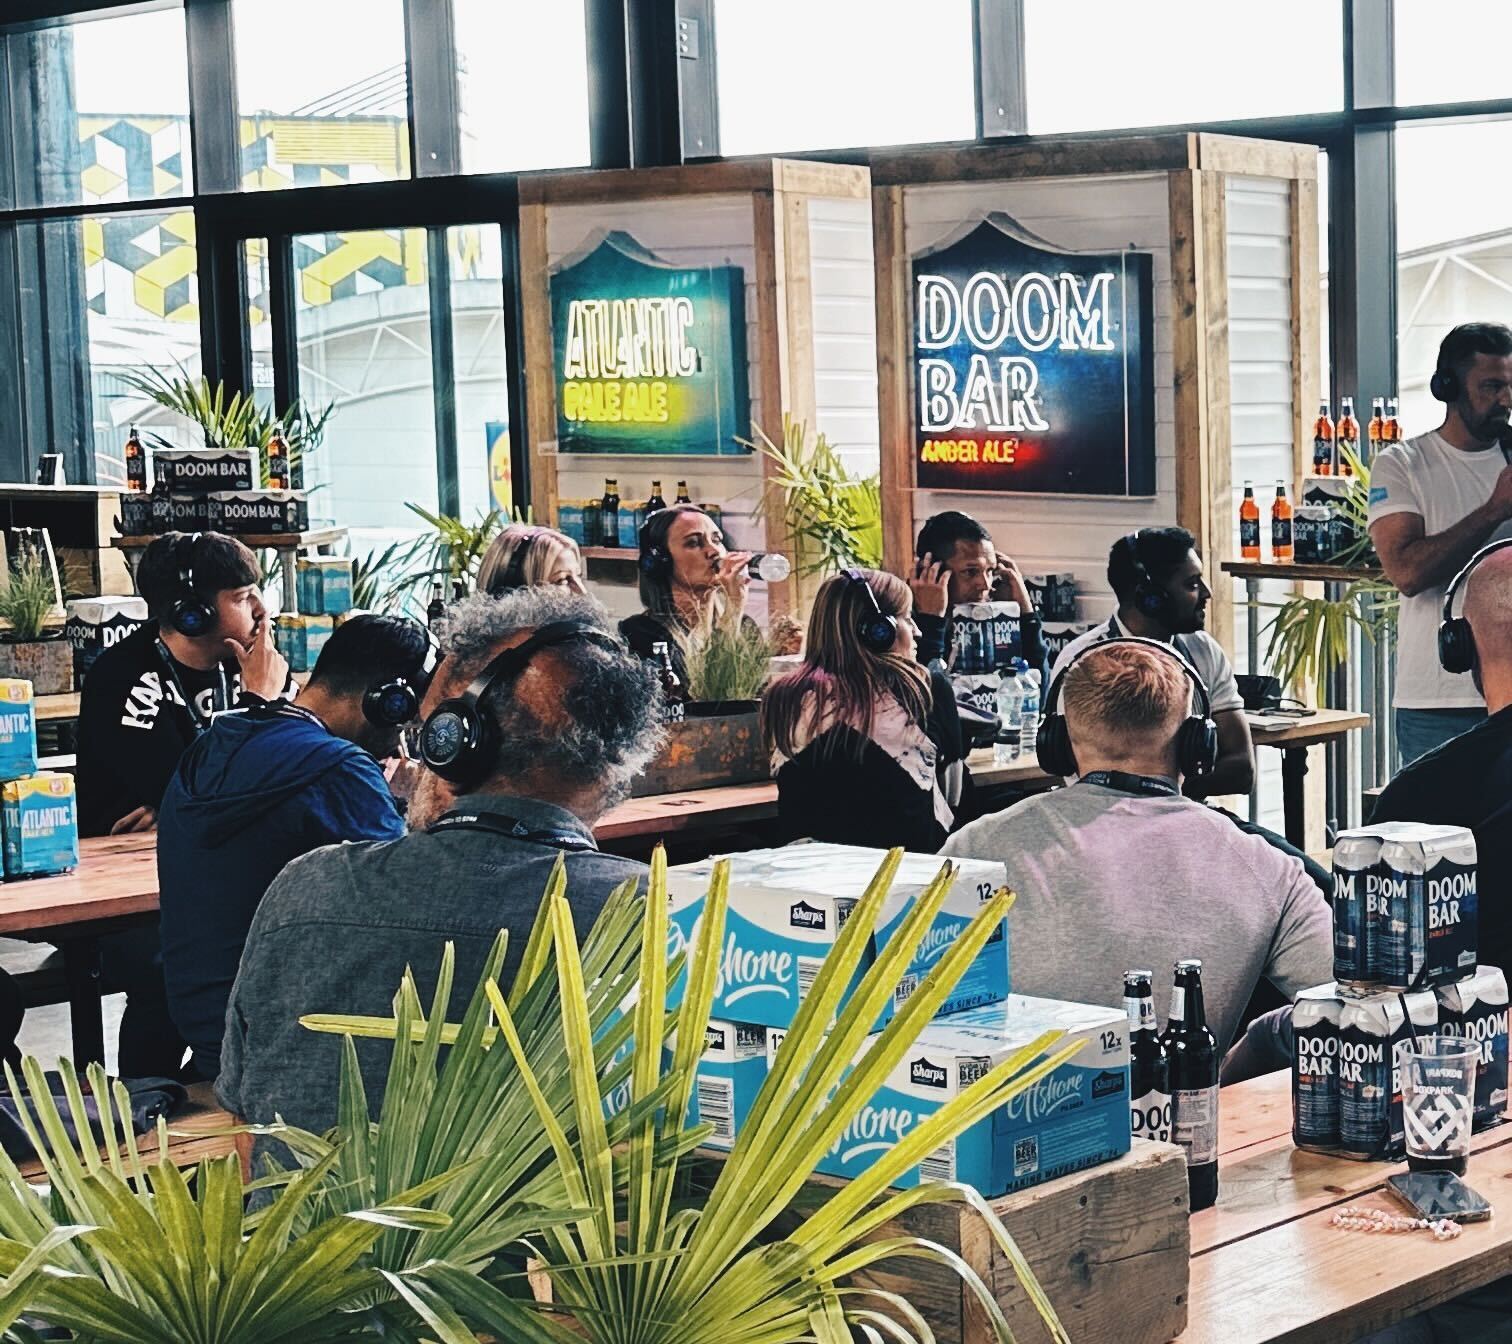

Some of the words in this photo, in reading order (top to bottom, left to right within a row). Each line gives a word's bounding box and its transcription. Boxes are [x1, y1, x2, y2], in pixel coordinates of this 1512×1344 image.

[917, 271, 1115, 352] DOOM
[564, 297, 698, 380] ATLANTIC
[563, 381, 622, 422] PALE
[622, 381, 669, 423] ALE
[918, 354, 1050, 433] BAR
[920, 440, 979, 463] AMBER
[981, 439, 1016, 463] ALE
[175, 462, 218, 477] DOOM
[219, 461, 248, 476] BAR
[224, 504, 258, 518] DOOM
[258, 504, 281, 518] BAR
[66, 625, 96, 640] DOOM
[995, 633, 1013, 645] BAR
[22, 805, 71, 830] ATLANTIC
[1428, 870, 1477, 905] DOOM
[1428, 900, 1461, 929] BAR
[1465, 1010, 1508, 1042] DOOM
[1099, 1030, 1122, 1050] 12x
[1298, 1055, 1334, 1076] BAR
